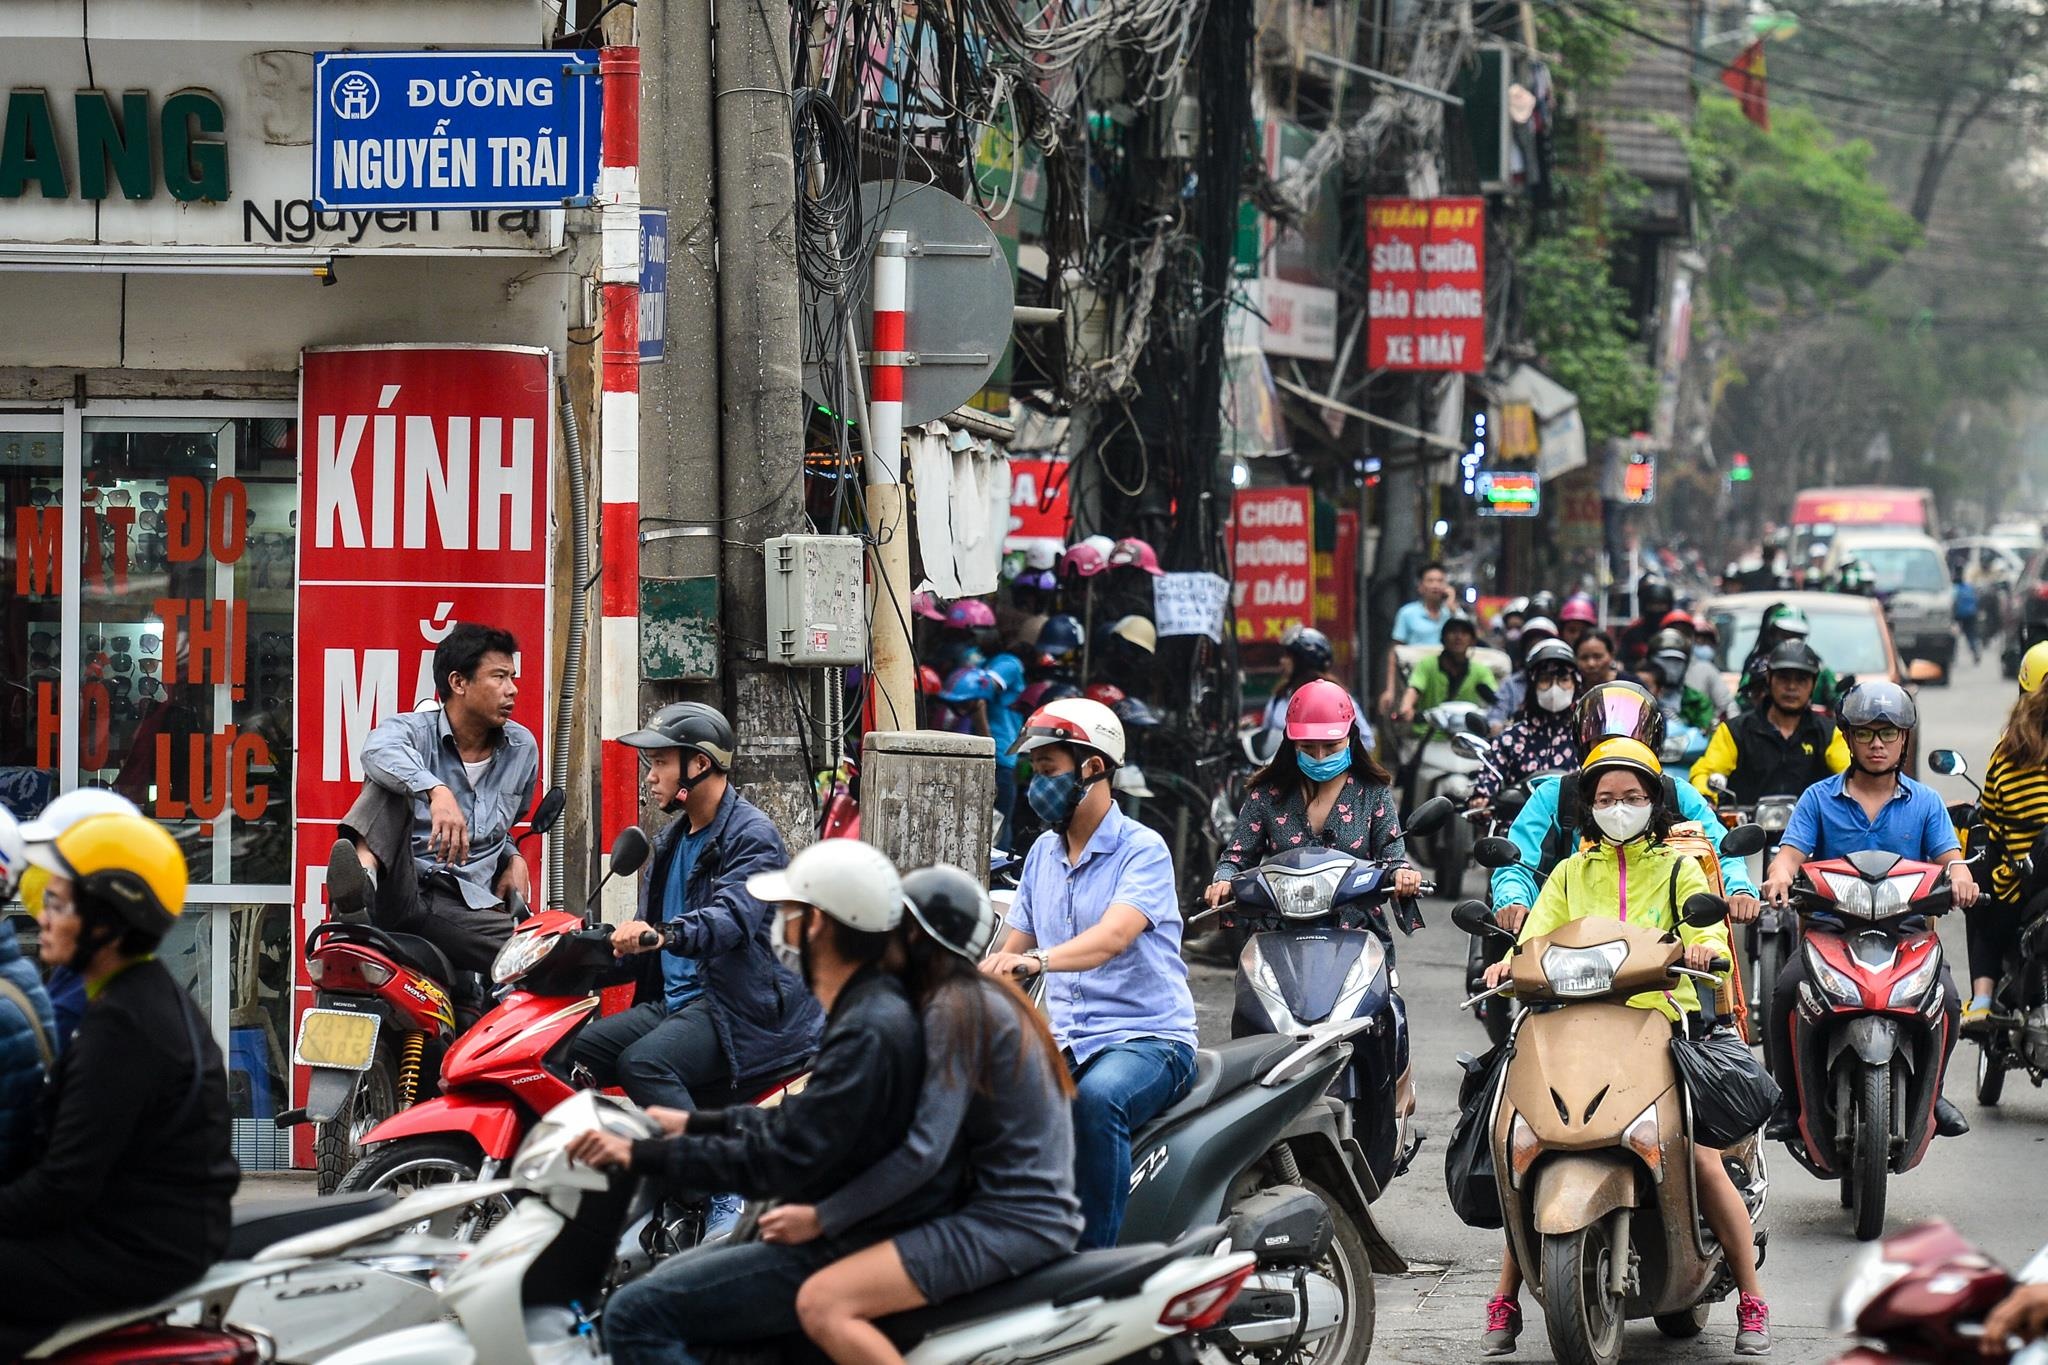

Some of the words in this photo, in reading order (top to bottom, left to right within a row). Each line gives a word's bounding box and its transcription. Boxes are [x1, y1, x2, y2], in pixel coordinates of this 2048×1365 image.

[407, 70, 553, 106] ĐƯỜNG
[333, 118, 476, 190] NGUYỄN
[488, 127, 567, 187] TRÃI
[1371, 234, 1416, 273] SỬA
[1420, 238, 1478, 273] CHỮA
[1368, 280, 1410, 318] BẢO
[1386, 335, 1413, 364] XE
[1418, 329, 1466, 364] MÁY
[315, 384, 535, 551] KÍNH
[166, 476, 248, 564] ĐO
[1239, 497, 1304, 528] CHỮA
[154, 599, 246, 700] THỊ
[155, 724, 270, 836] LỰC
[402, 982, 428, 1002] wave
[512, 1073, 547, 1085] HONDA
